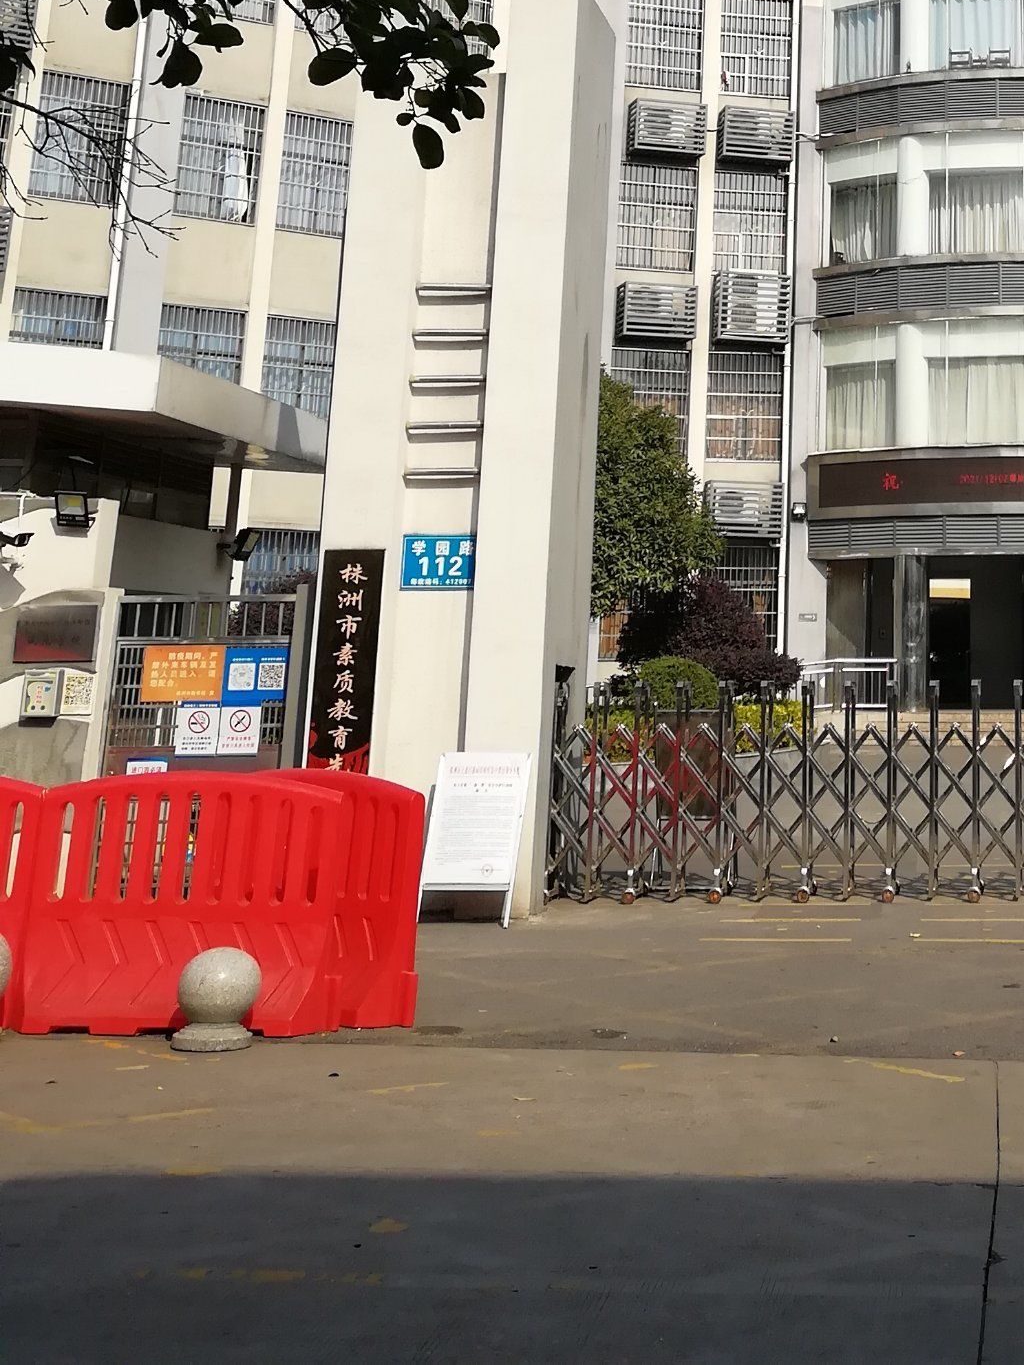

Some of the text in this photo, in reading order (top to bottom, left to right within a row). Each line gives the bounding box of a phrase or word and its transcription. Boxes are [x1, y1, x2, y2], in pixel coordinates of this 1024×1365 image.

[411, 540, 474, 556] 学园路
[418, 556, 463, 576] 112
